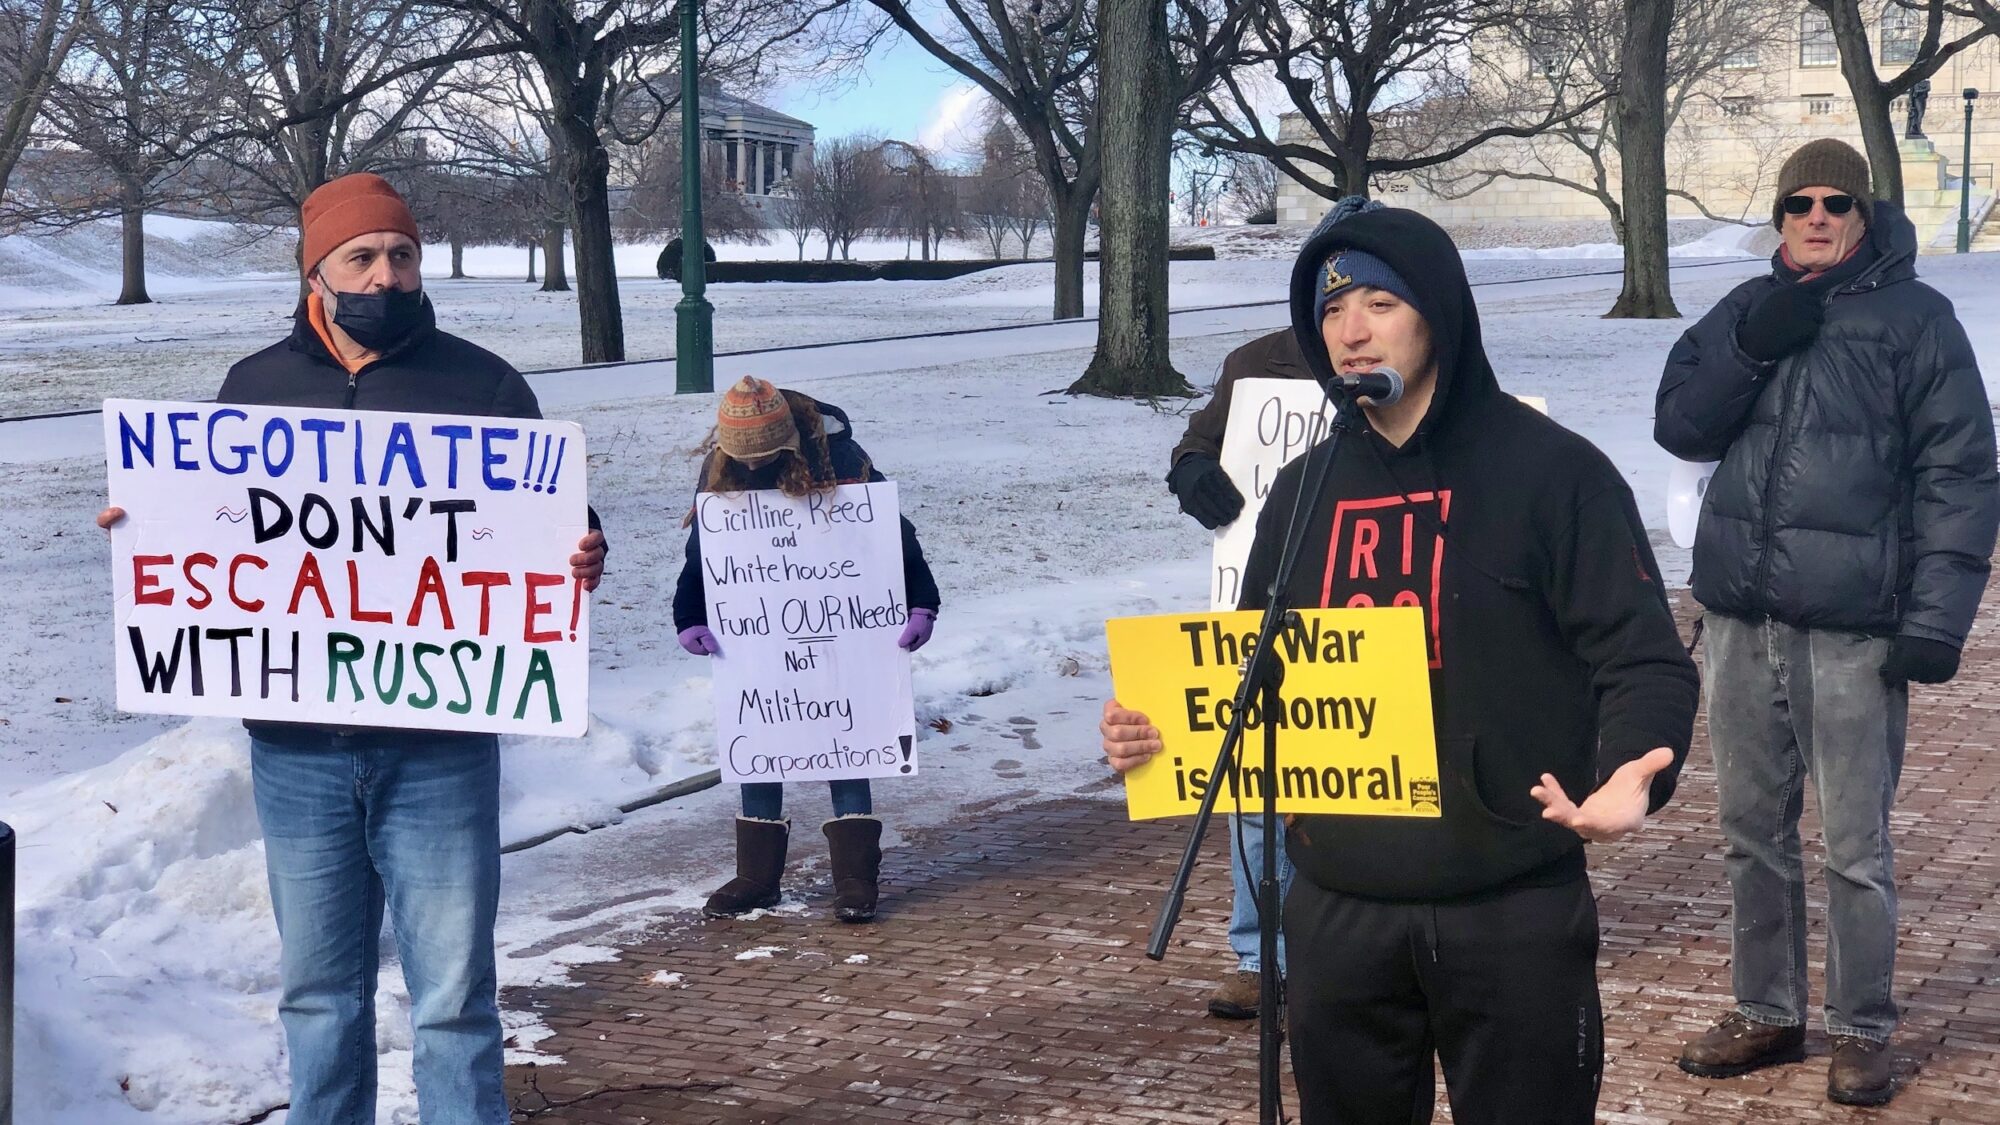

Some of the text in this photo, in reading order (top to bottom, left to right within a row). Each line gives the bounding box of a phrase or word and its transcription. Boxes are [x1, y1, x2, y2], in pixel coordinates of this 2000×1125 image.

[118, 408, 566, 495] NEGOTIATE!!!
[1257, 396, 1329, 463] Opp
[248, 487, 477, 563] DON'T
[701, 485, 874, 533] Cicilline, Reed
[771, 532, 797, 548] and
[133, 551, 584, 643] ESCALATE!
[715, 589, 906, 636] Fund OUR Needs
[784, 646, 818, 672] Not
[1180, 617, 1365, 667] The War
[128, 625, 563, 724] WITH RUSSIA
[739, 688, 852, 732] Military
[729, 735, 913, 778] Corporations!
[1174, 757, 1210, 801] is
